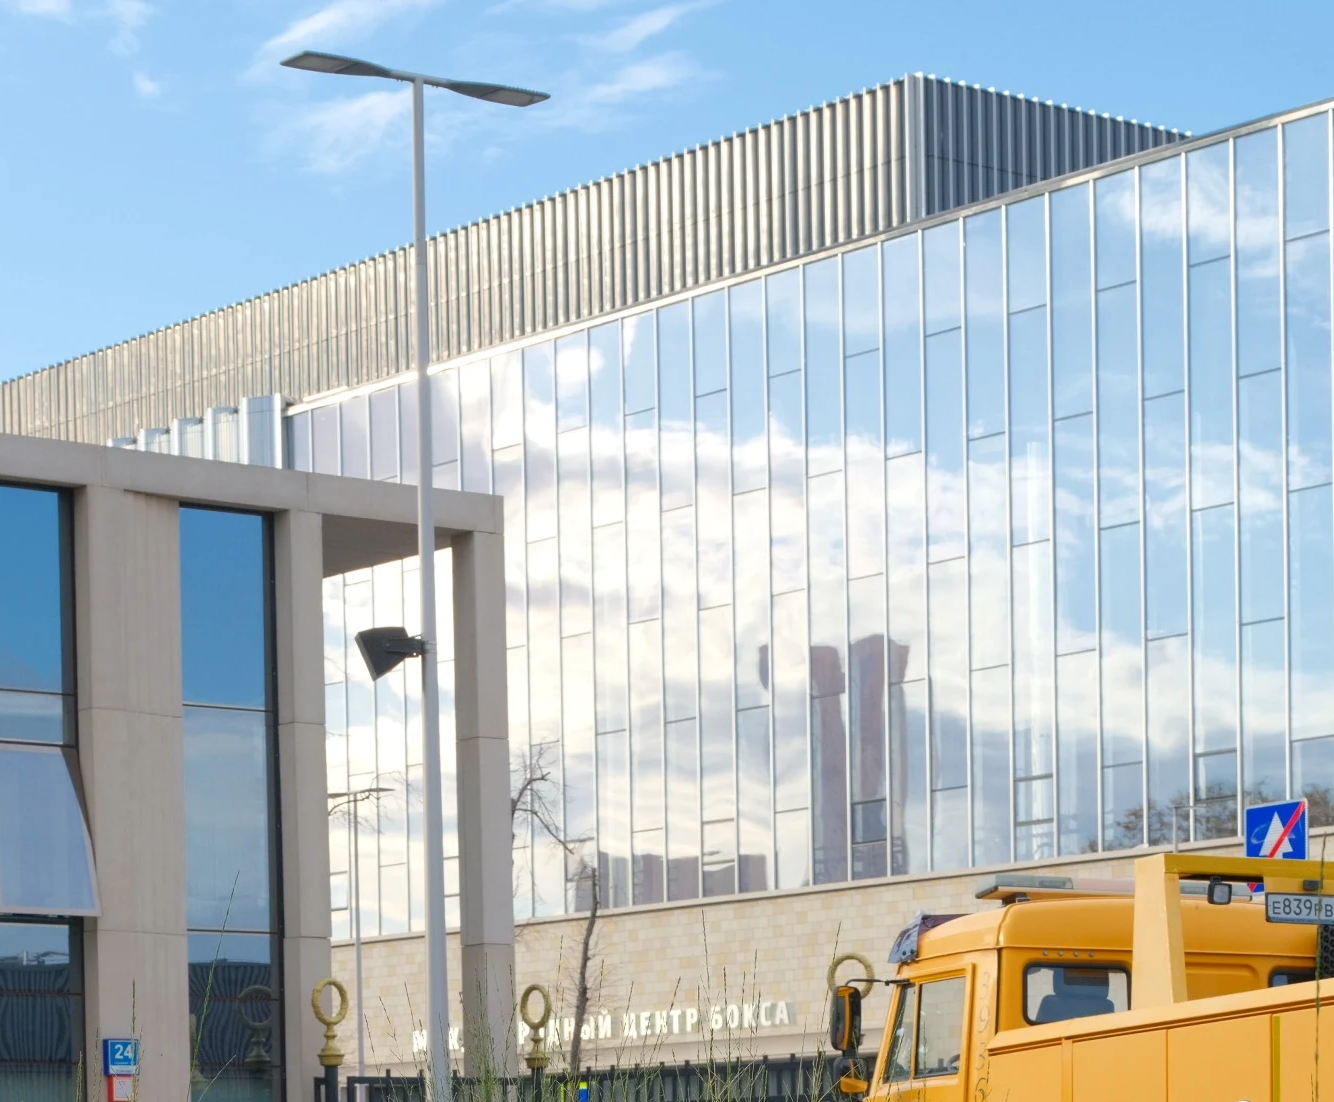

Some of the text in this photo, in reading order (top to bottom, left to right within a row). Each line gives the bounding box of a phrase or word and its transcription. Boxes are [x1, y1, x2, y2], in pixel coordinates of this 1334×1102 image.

[623, 1007, 699, 1039] ЦЕНТР
[710, 1000, 790, 1031] БОКСА
[114, 1044, 135, 1060] 24
